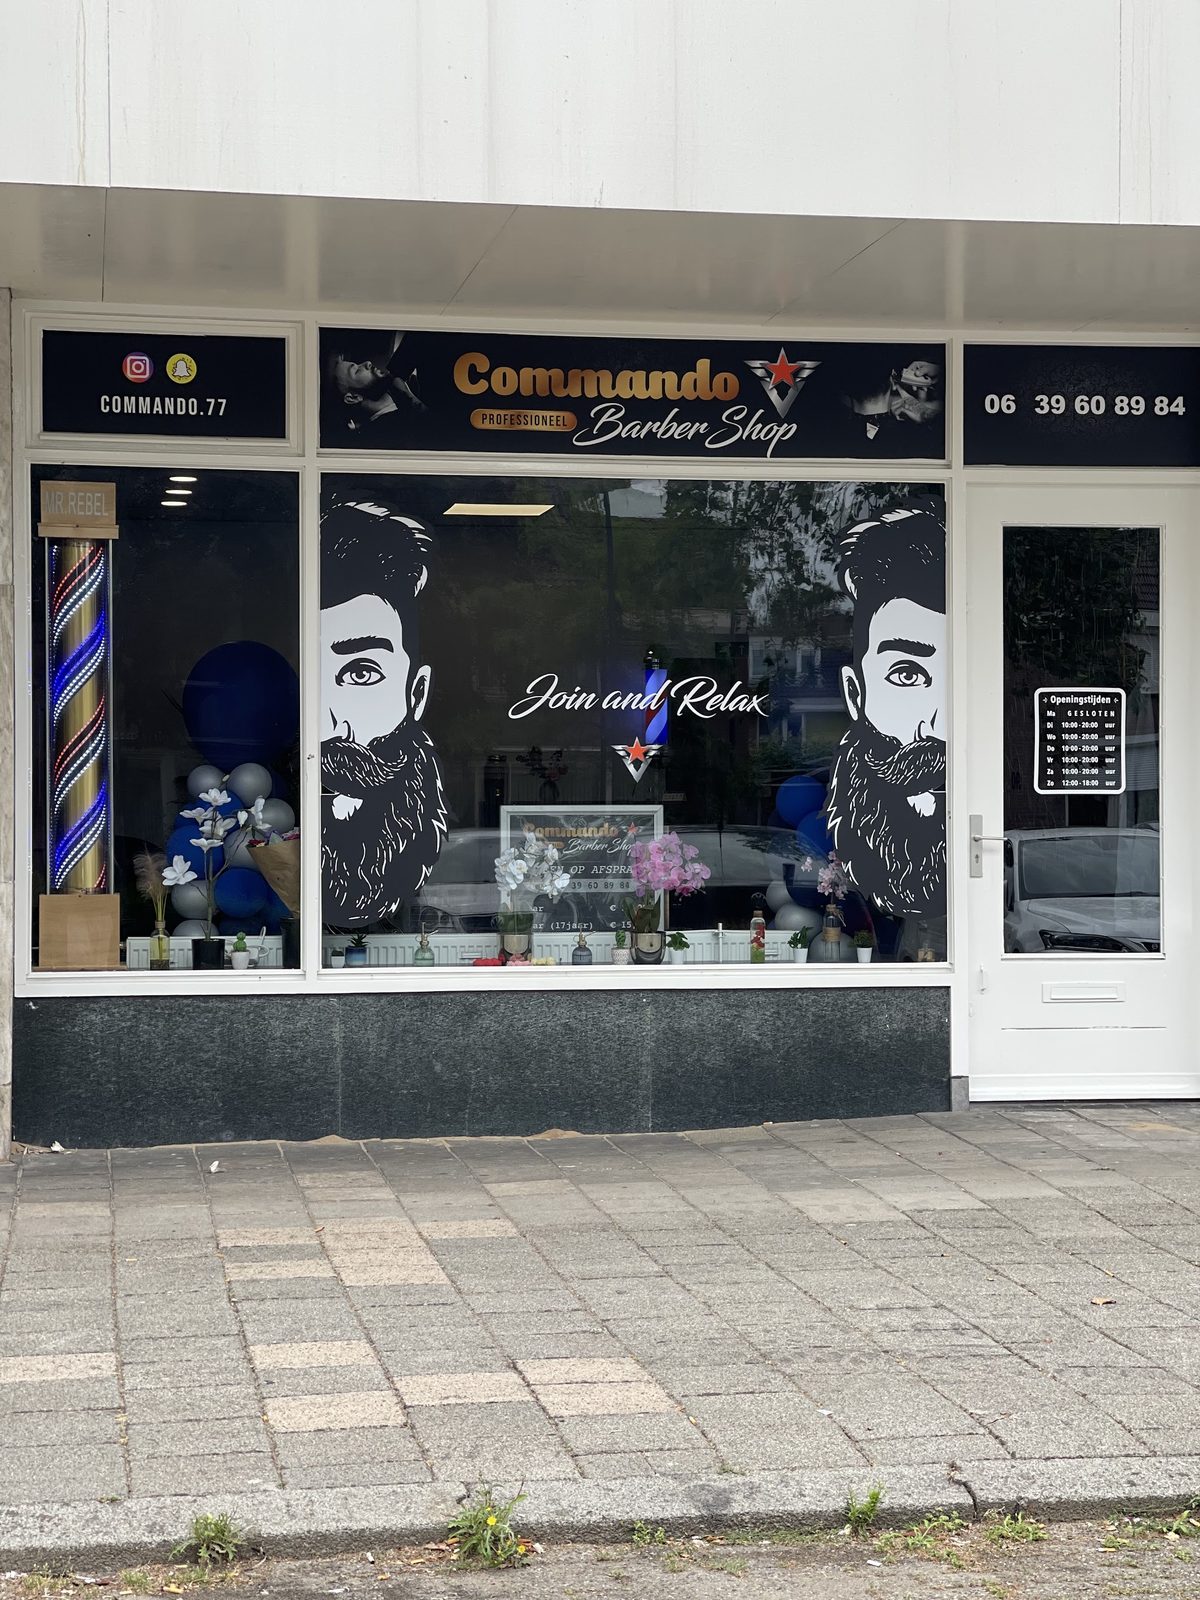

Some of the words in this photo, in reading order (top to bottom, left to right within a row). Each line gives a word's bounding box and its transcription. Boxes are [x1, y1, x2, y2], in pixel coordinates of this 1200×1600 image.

[453, 352, 740, 400] Commando
[100, 395, 227, 416] COMMANDO.77
[984, 394, 1017, 414] 06
[1034, 394, 1066, 415] 39
[1074, 395, 1106, 415] 60
[1114, 395, 1146, 416] 89
[1154, 396, 1186, 416] 84
[481, 412, 568, 428] PROFESSIONEEL
[572, 402, 709, 447] Barber
[704, 405, 798, 459] Shop
[508, 673, 600, 719] Join
[601, 679, 672, 711] and
[670, 675, 770, 719] Relax
[1050, 694, 1111, 706] Openingstijden
[1046, 721, 1054, 729] Di
[562, 838, 608, 854] Barber
[591, 866, 632, 874] AFSPRA
[571, 881, 582, 890] 39
[588, 881, 598, 890] 60
[604, 881, 614, 890] 89
